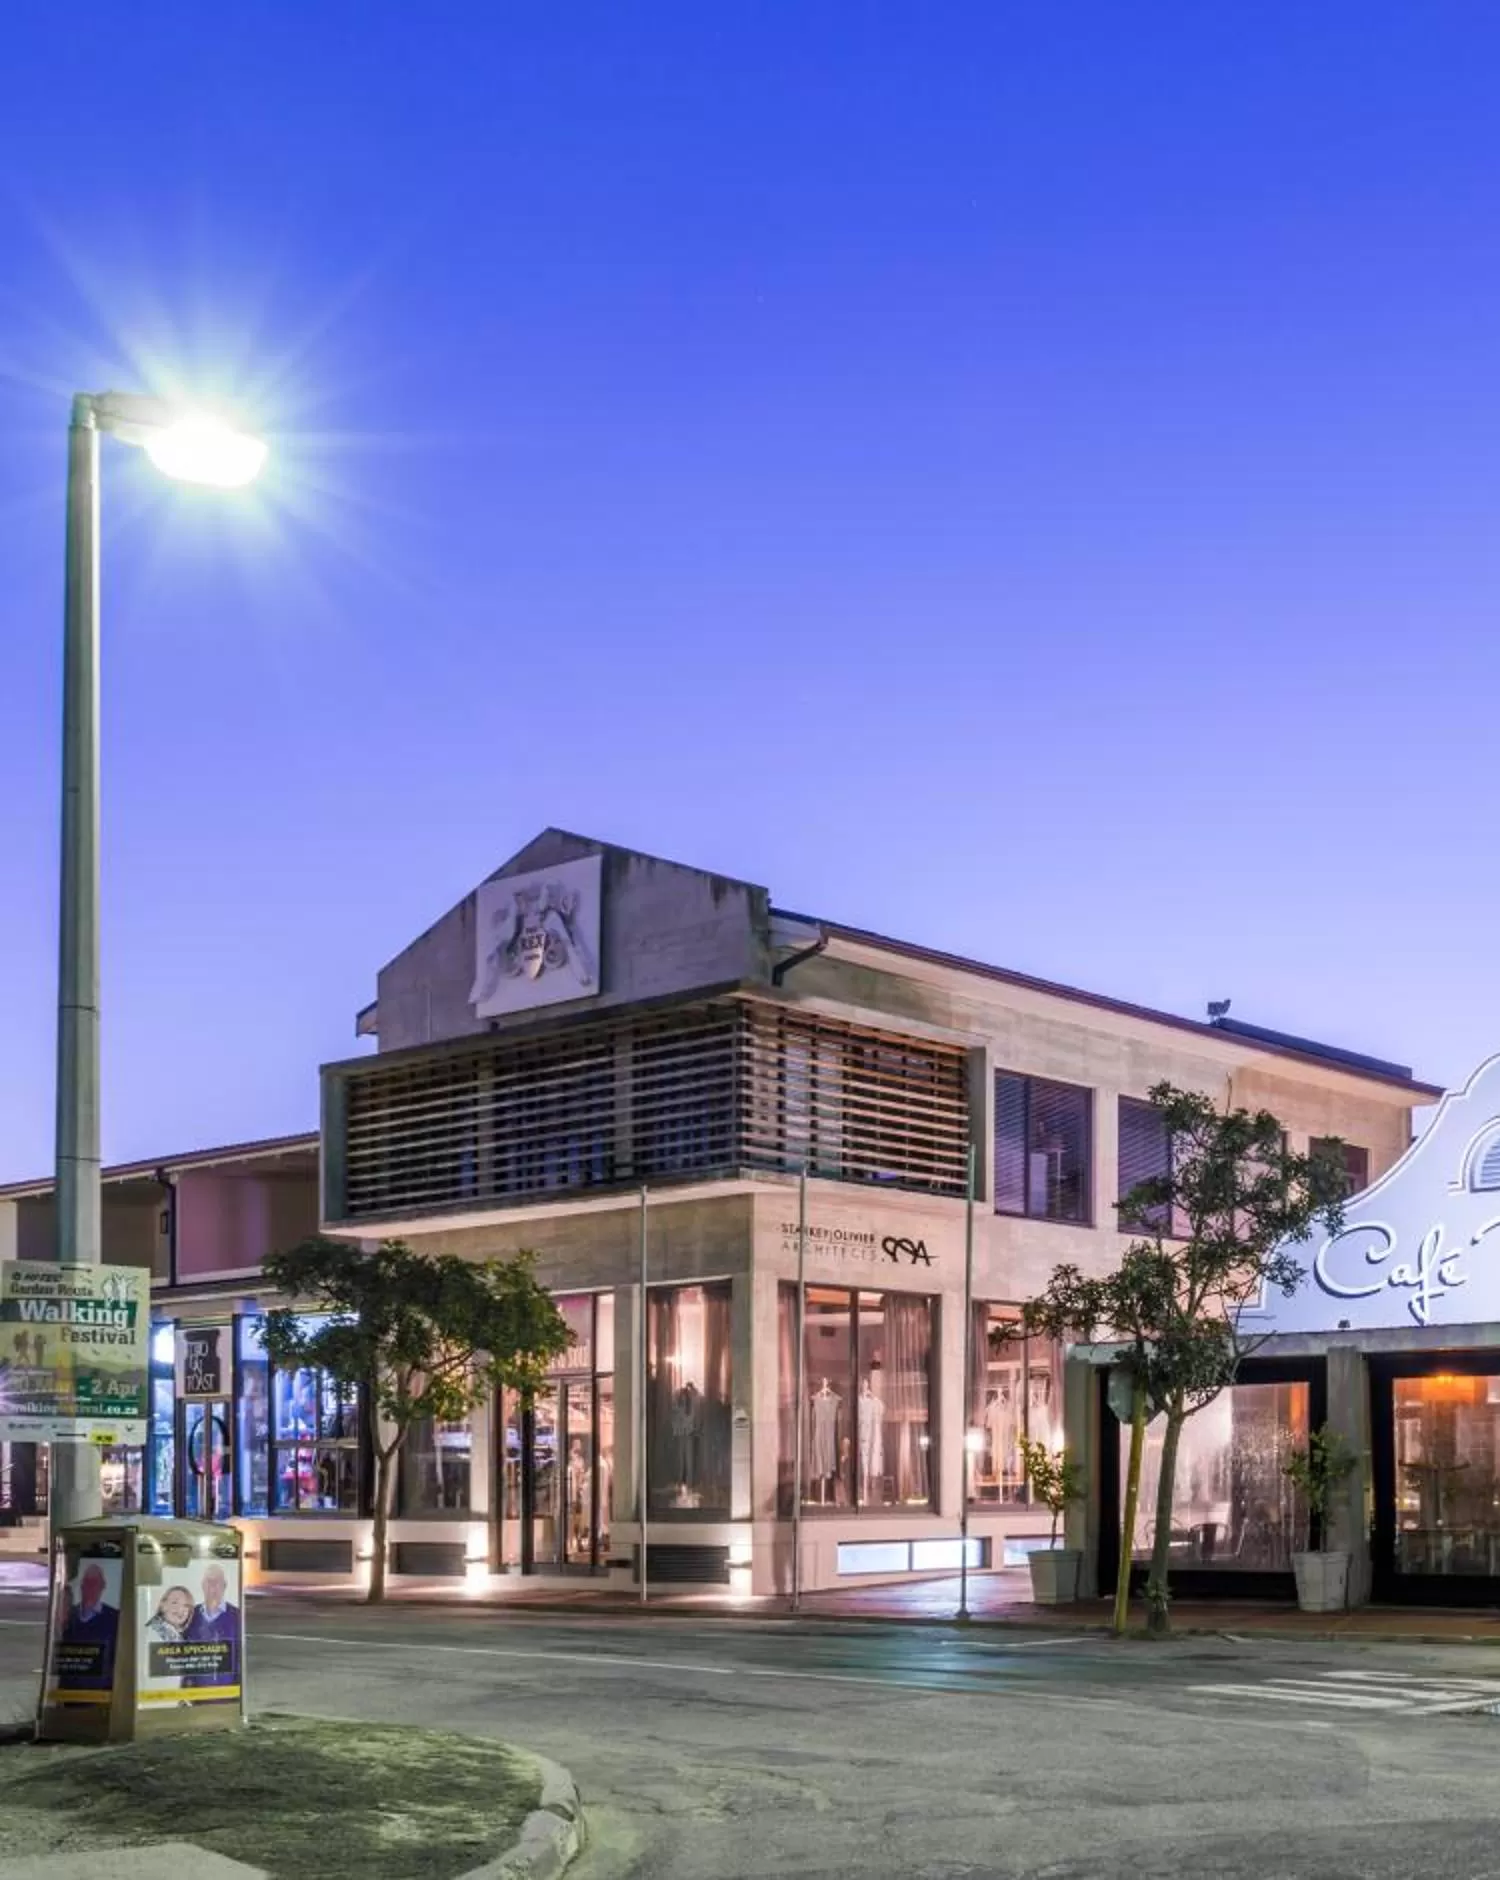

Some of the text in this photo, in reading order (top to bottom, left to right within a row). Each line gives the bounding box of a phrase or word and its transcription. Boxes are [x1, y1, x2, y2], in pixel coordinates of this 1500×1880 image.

[1313, 1219, 1468, 1325] Café
[11, 1282, 94, 1297] Garden Route
[18, 1299, 129, 1332] Walking
[60, 1327, 136, 1345] Festival
[91, 1379, 103, 1395] 2
[107, 1380, 140, 1399] Apr
